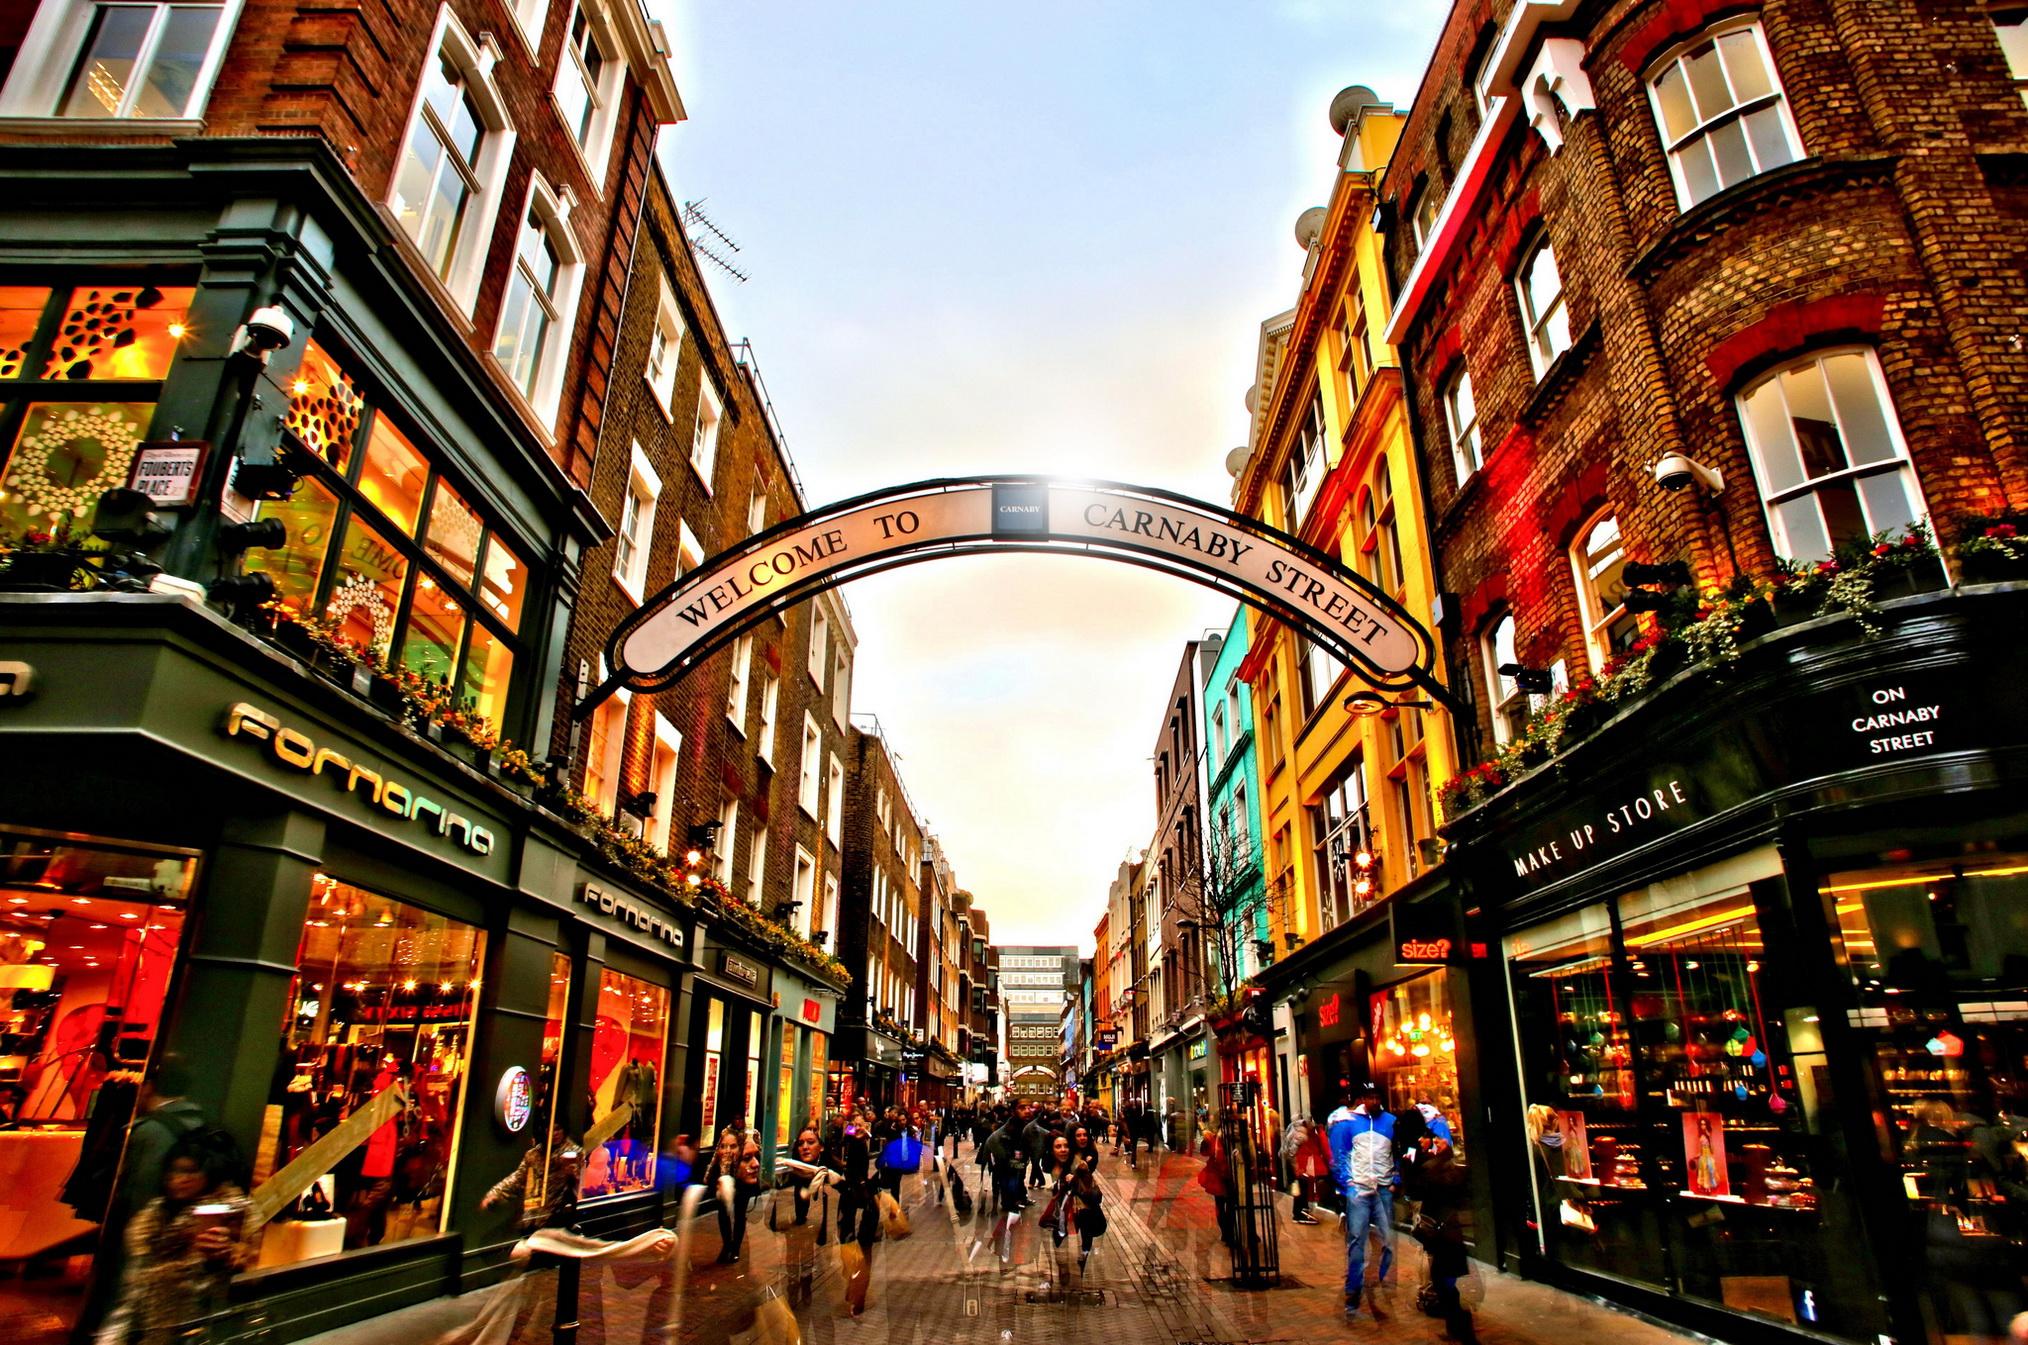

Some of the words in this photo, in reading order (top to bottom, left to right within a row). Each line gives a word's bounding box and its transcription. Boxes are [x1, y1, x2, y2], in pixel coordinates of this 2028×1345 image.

[138, 480, 172, 495] PLACE
[1000, 505, 1041, 513] CARNABY
[676, 529, 848, 629] WELCOME
[873, 510, 920, 540] TO
[1083, 503, 1254, 567] CARNABY
[1265, 559, 1389, 646] STREET
[1872, 686, 1905, 704] ON
[1852, 705, 1940, 732] CARNABY
[1870, 731, 1934, 753] STREET
[1514, 841, 1562, 877] MAKE
[1570, 824, 1594, 850] UP
[1606, 780, 1686, 833] STORE
[1401, 938, 1452, 959] size?
